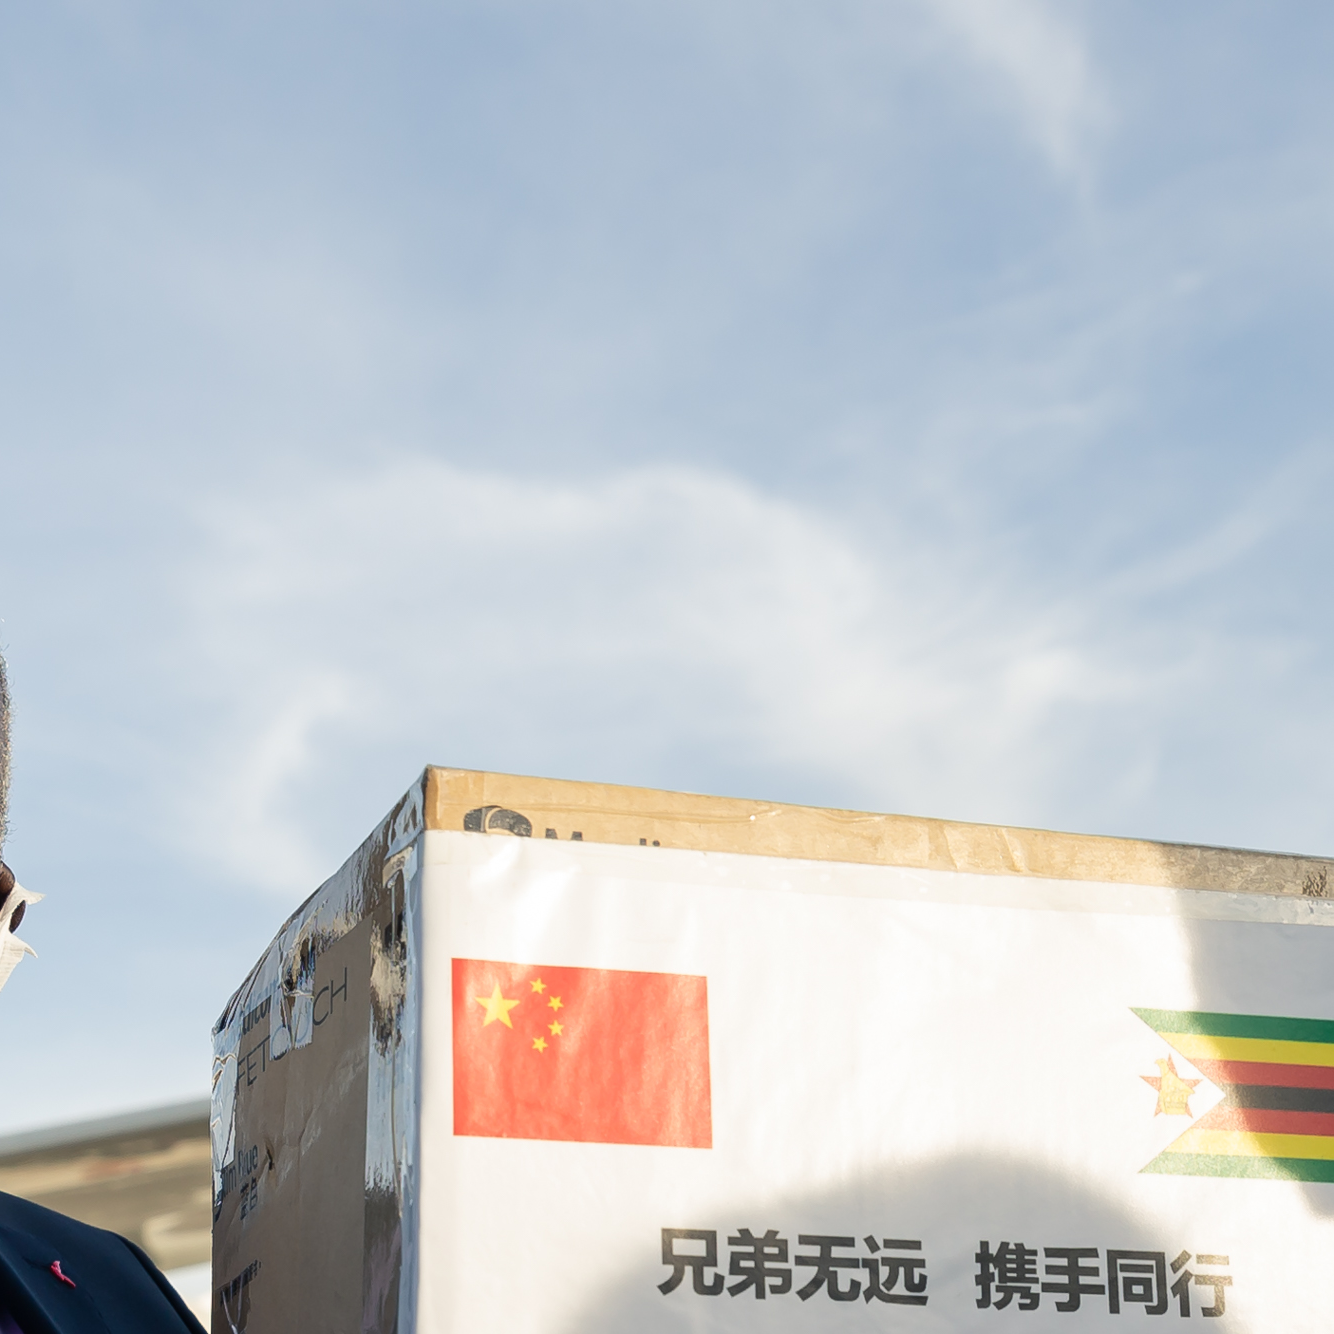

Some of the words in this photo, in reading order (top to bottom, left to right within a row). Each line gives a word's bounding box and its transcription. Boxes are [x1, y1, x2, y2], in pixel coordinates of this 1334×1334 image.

[237, 966, 348, 1097] FETOUCH
[657, 1227, 930, 1307] 兄弟无远
[974, 1239, 1234, 1319] 携手同行
